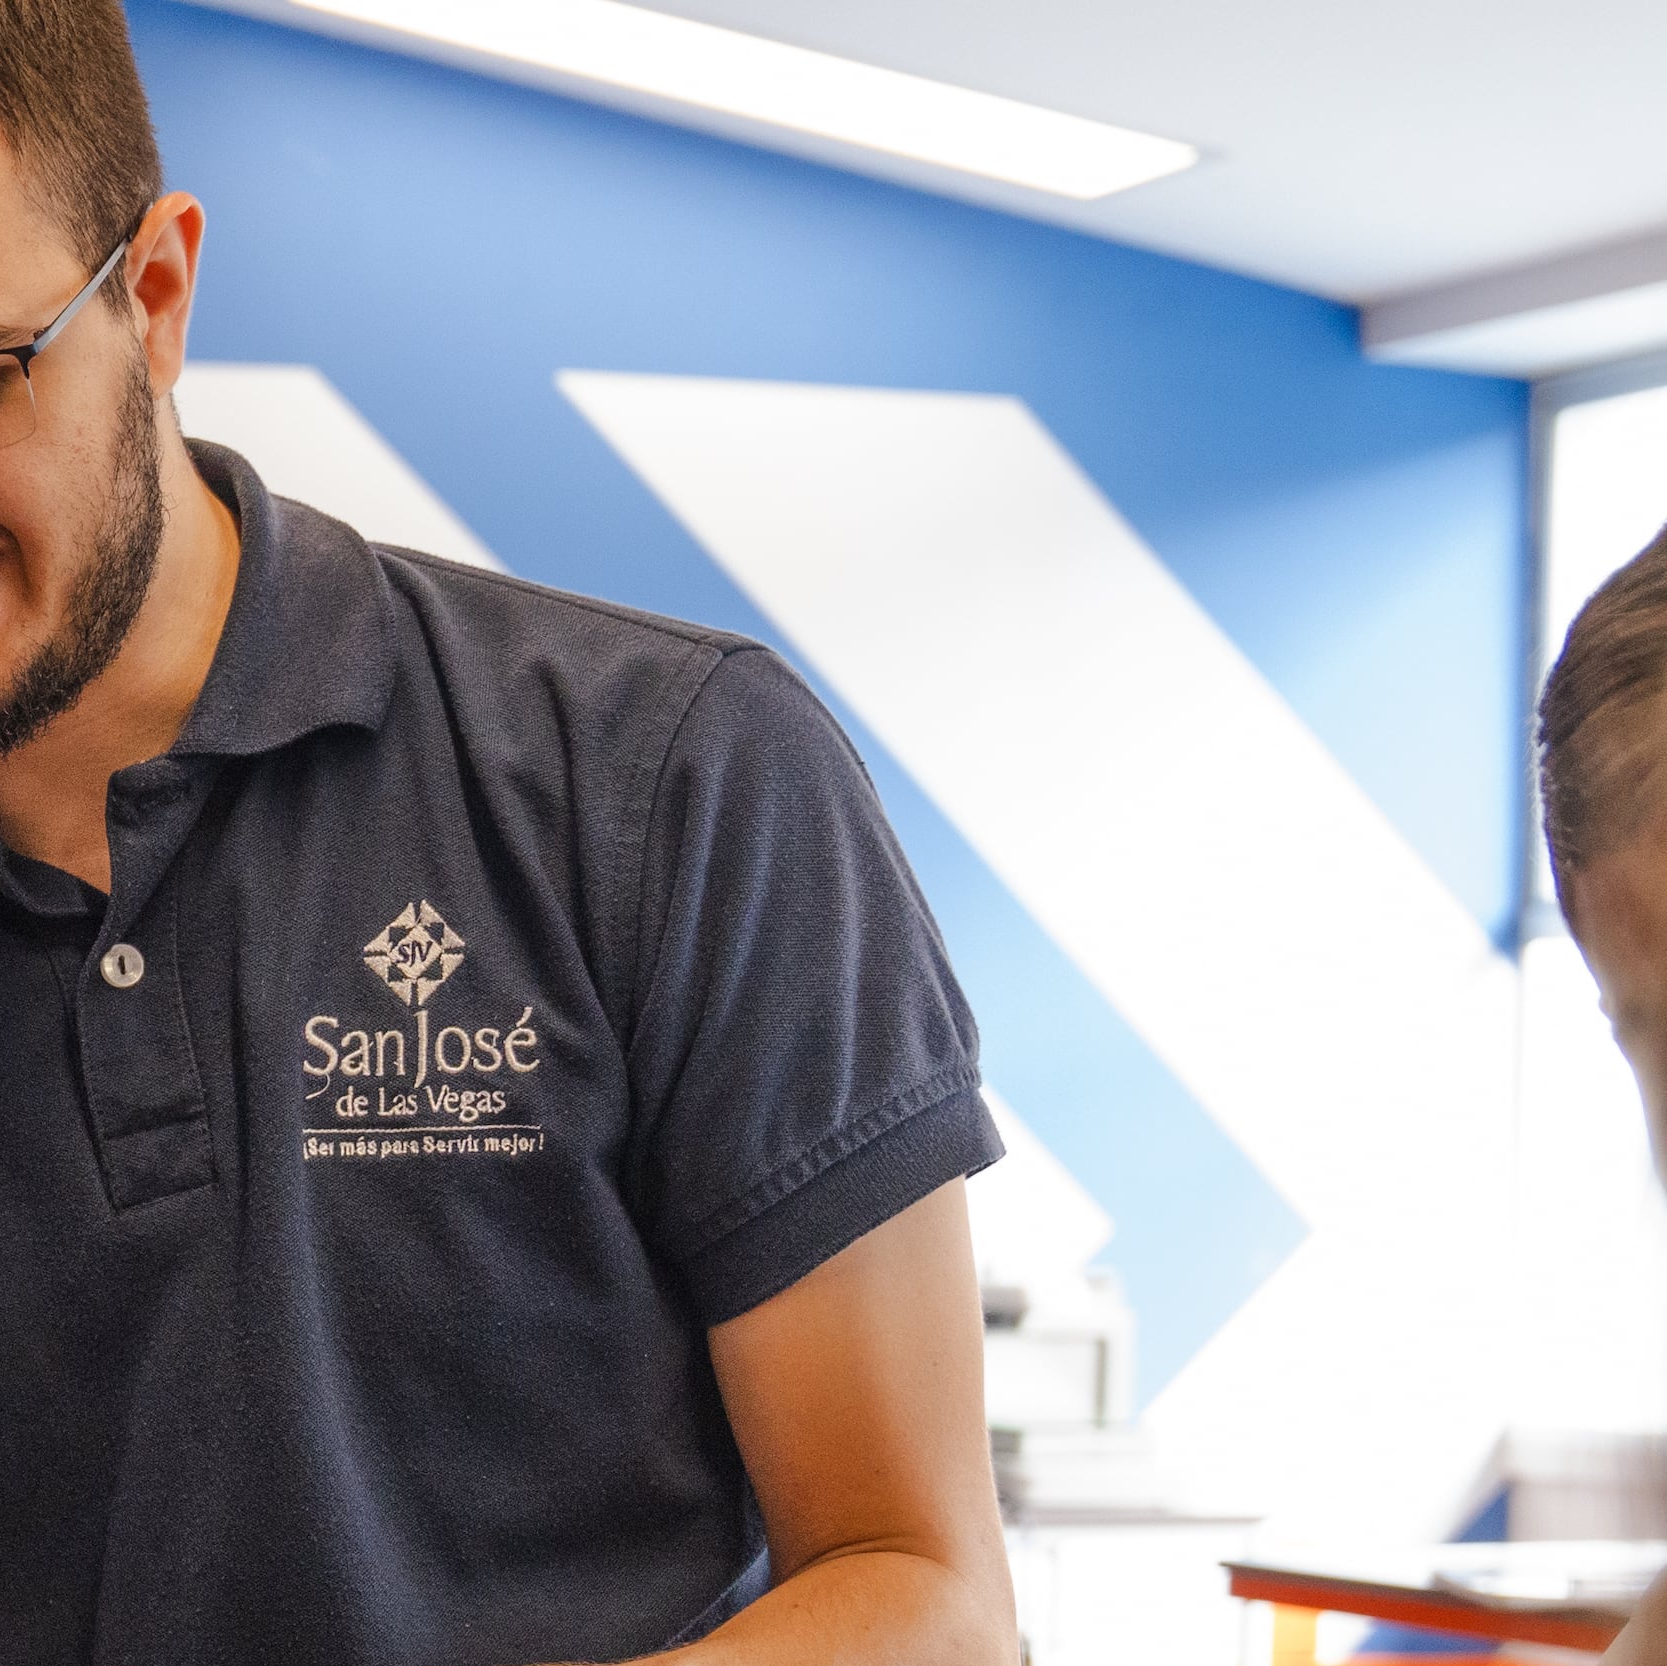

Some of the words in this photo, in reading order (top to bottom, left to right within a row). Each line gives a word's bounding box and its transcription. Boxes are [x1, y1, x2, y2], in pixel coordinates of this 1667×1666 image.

[335, 1086, 369, 1117] de
[377, 1088, 418, 1117] Las
[425, 1085, 507, 1123] Vegas
[340, 1136, 377, 1157] más
[380, 1138, 419, 1159] para
[422, 1135, 479, 1155] Servir
